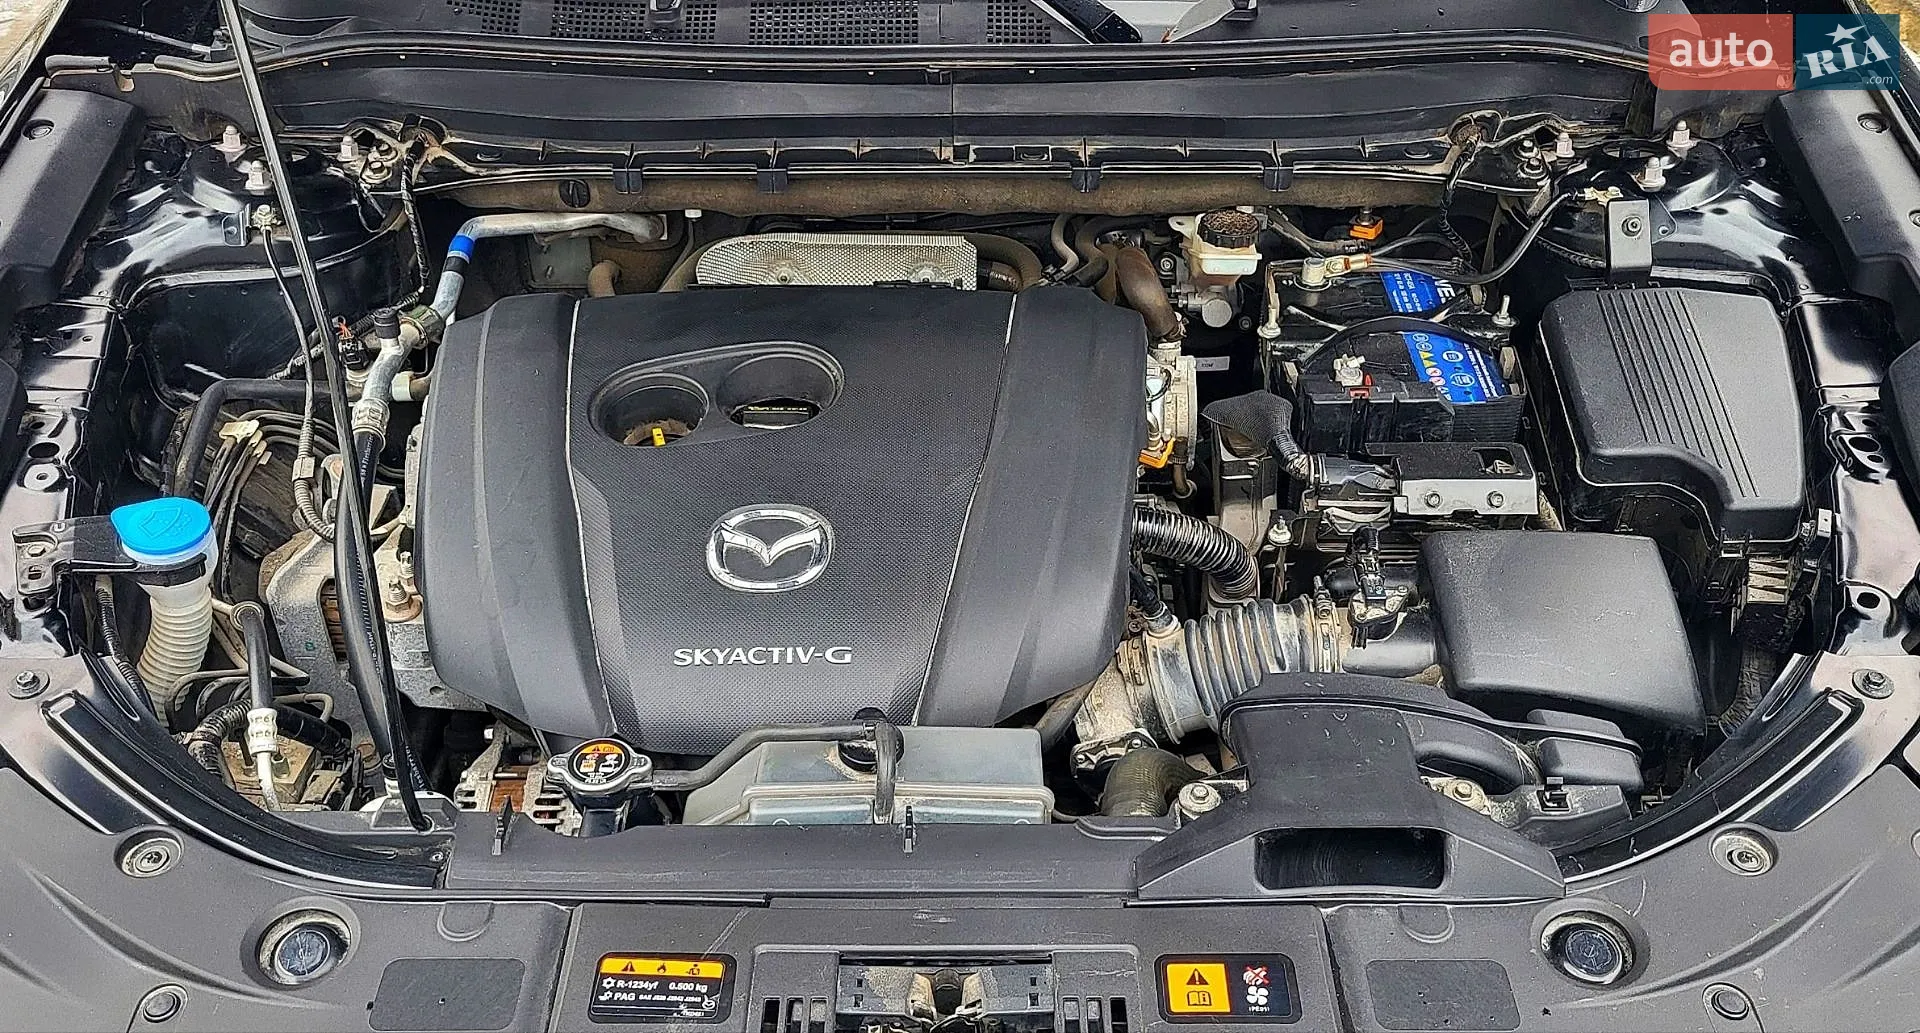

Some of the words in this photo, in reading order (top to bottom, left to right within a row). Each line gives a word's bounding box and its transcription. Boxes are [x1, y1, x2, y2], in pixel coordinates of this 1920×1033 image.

[673, 646, 852, 666] SKYACTIV-G
[617, 980, 659, 990] R-1234yf
[669, 982, 694, 991] 0.500
[695, 983, 708, 993] kg
[613, 992, 636, 1001] PAG
